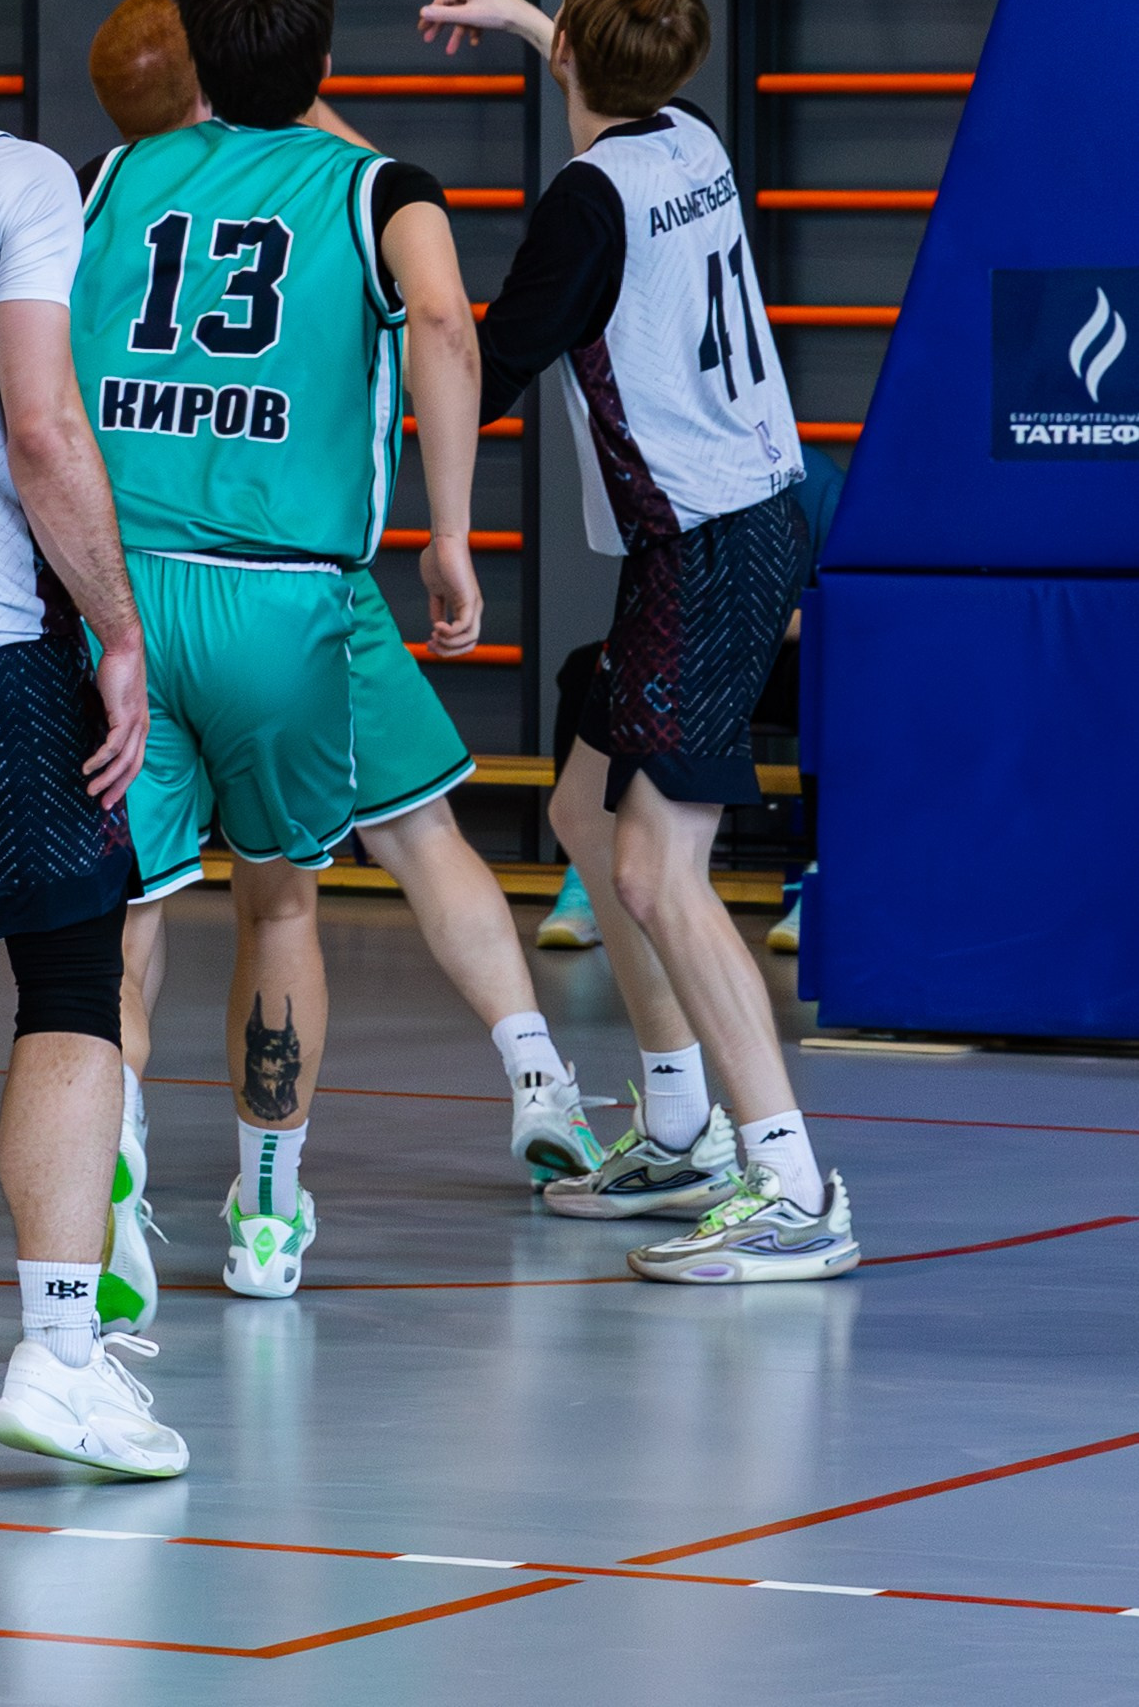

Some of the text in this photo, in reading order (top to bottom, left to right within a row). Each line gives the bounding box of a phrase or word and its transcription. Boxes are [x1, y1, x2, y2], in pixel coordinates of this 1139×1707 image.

[126, 209, 295, 359] 13
[698, 233, 766, 403] 41
[98, 376, 291, 443] КИРОВ
